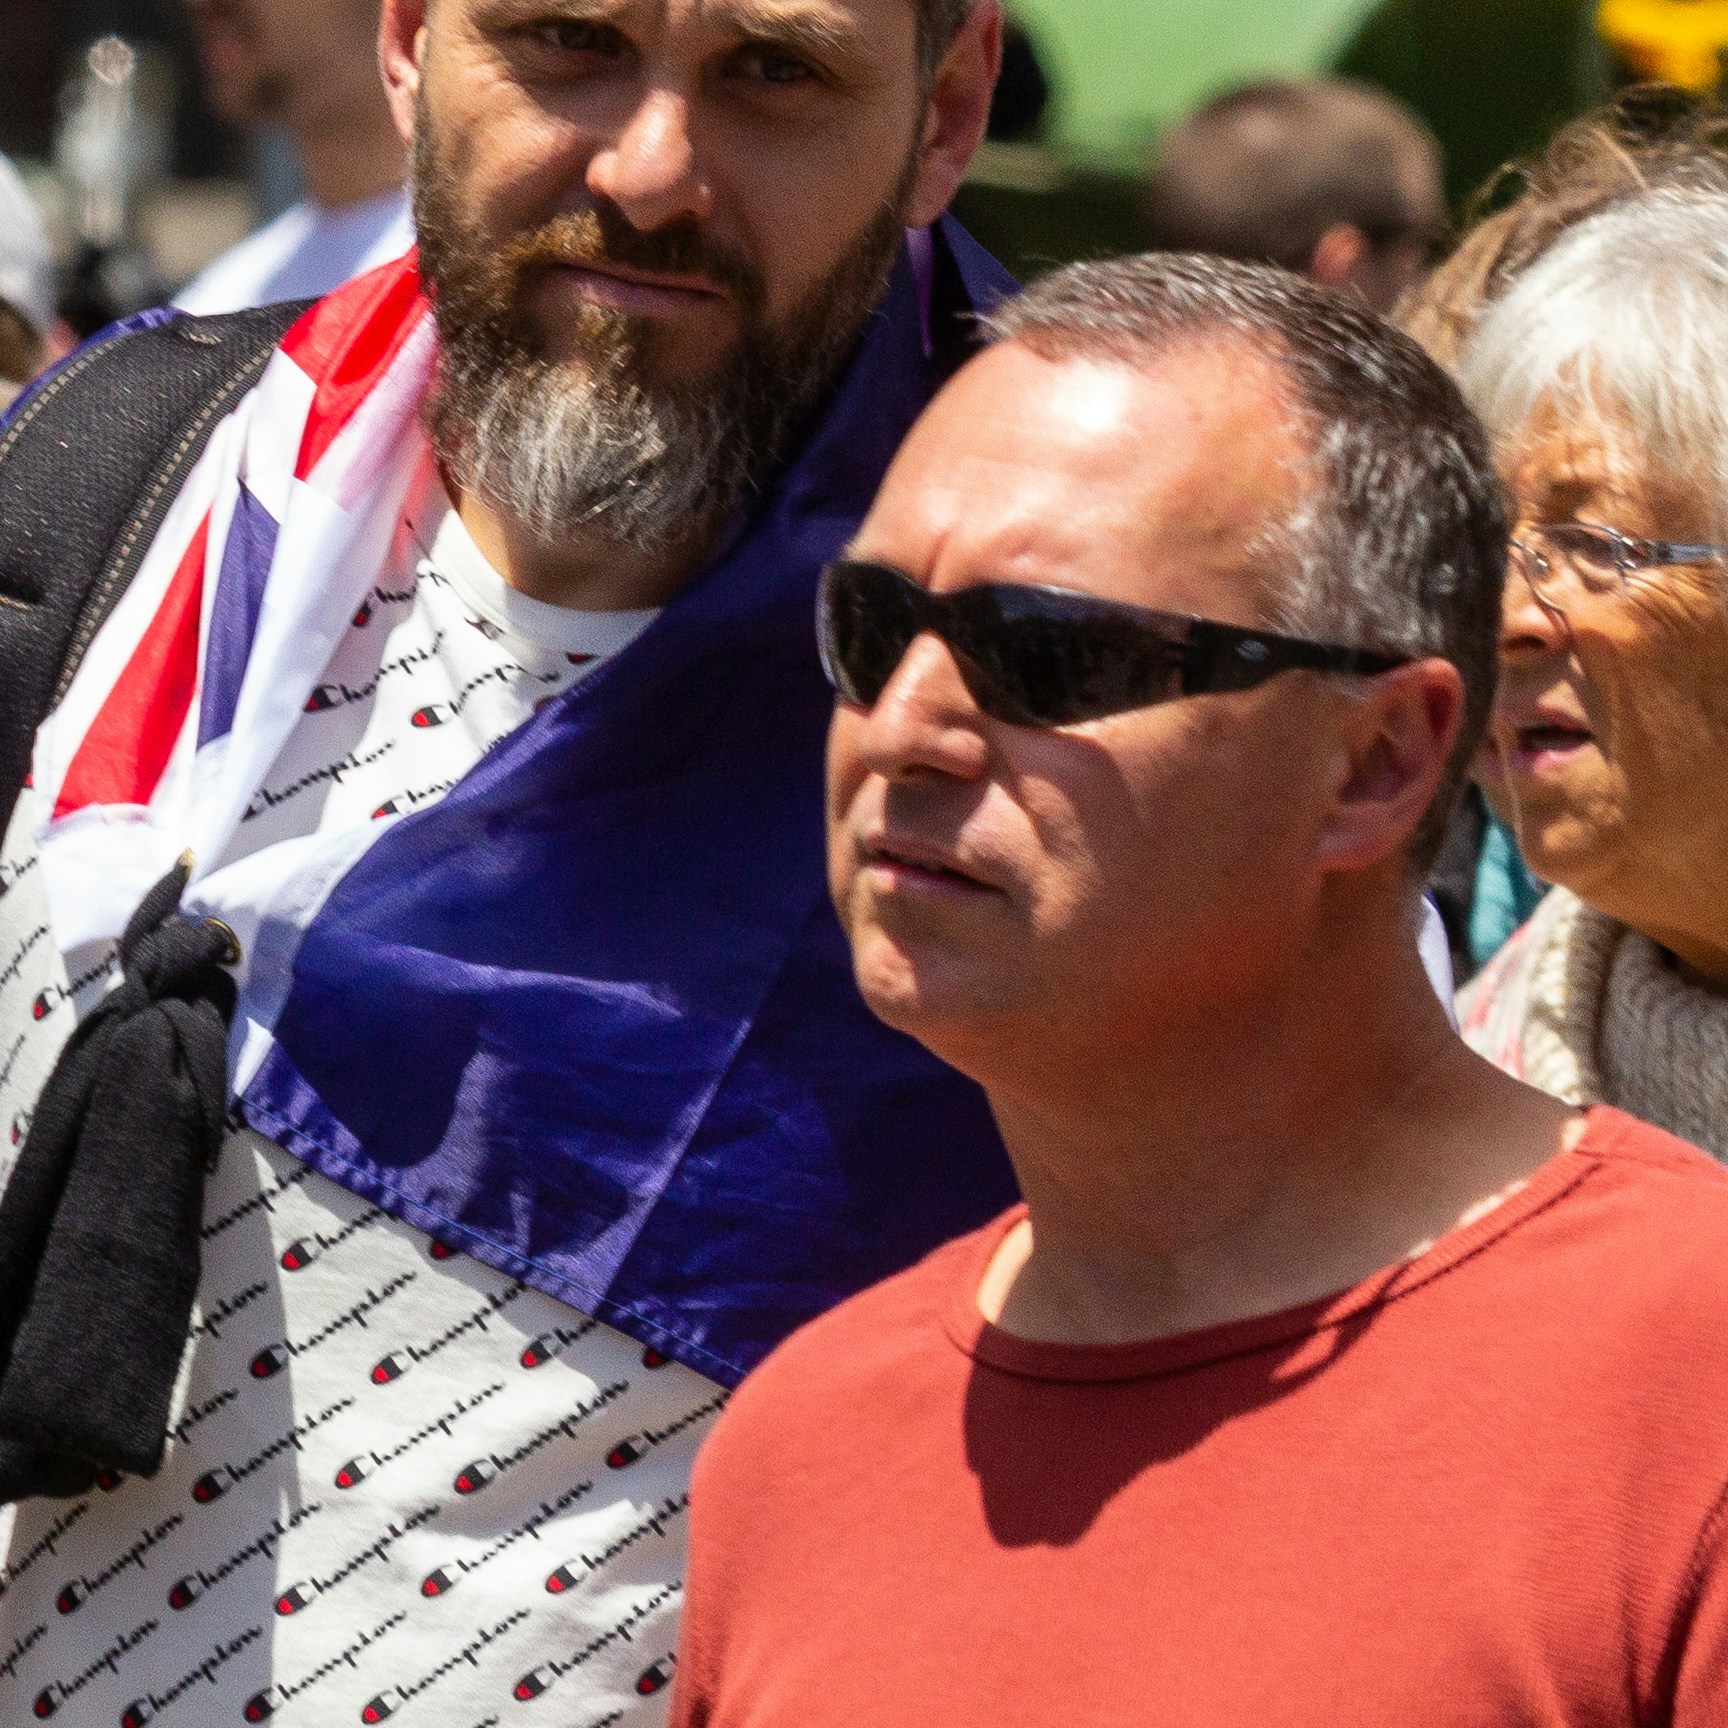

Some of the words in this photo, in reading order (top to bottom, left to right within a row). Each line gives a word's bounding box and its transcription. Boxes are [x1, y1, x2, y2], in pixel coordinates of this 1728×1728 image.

[251, 1271, 418, 1379] Champion
[193, 1398, 356, 1504] Champion
[334, 1383, 506, 1489] Champion
[454, 1380, 629, 1495] Champion
[57, 1513, 184, 1615] Champion
[168, 1503, 321, 1611] Champion
[274, 1504, 440, 1617] Champion
[421, 1480, 593, 1599] Champion
[34, 1618, 158, 1720] Champion
[244, 1610, 407, 1724] Champion
[361, 1609, 531, 1725] Champion
[513, 1579, 682, 1702] Champion
